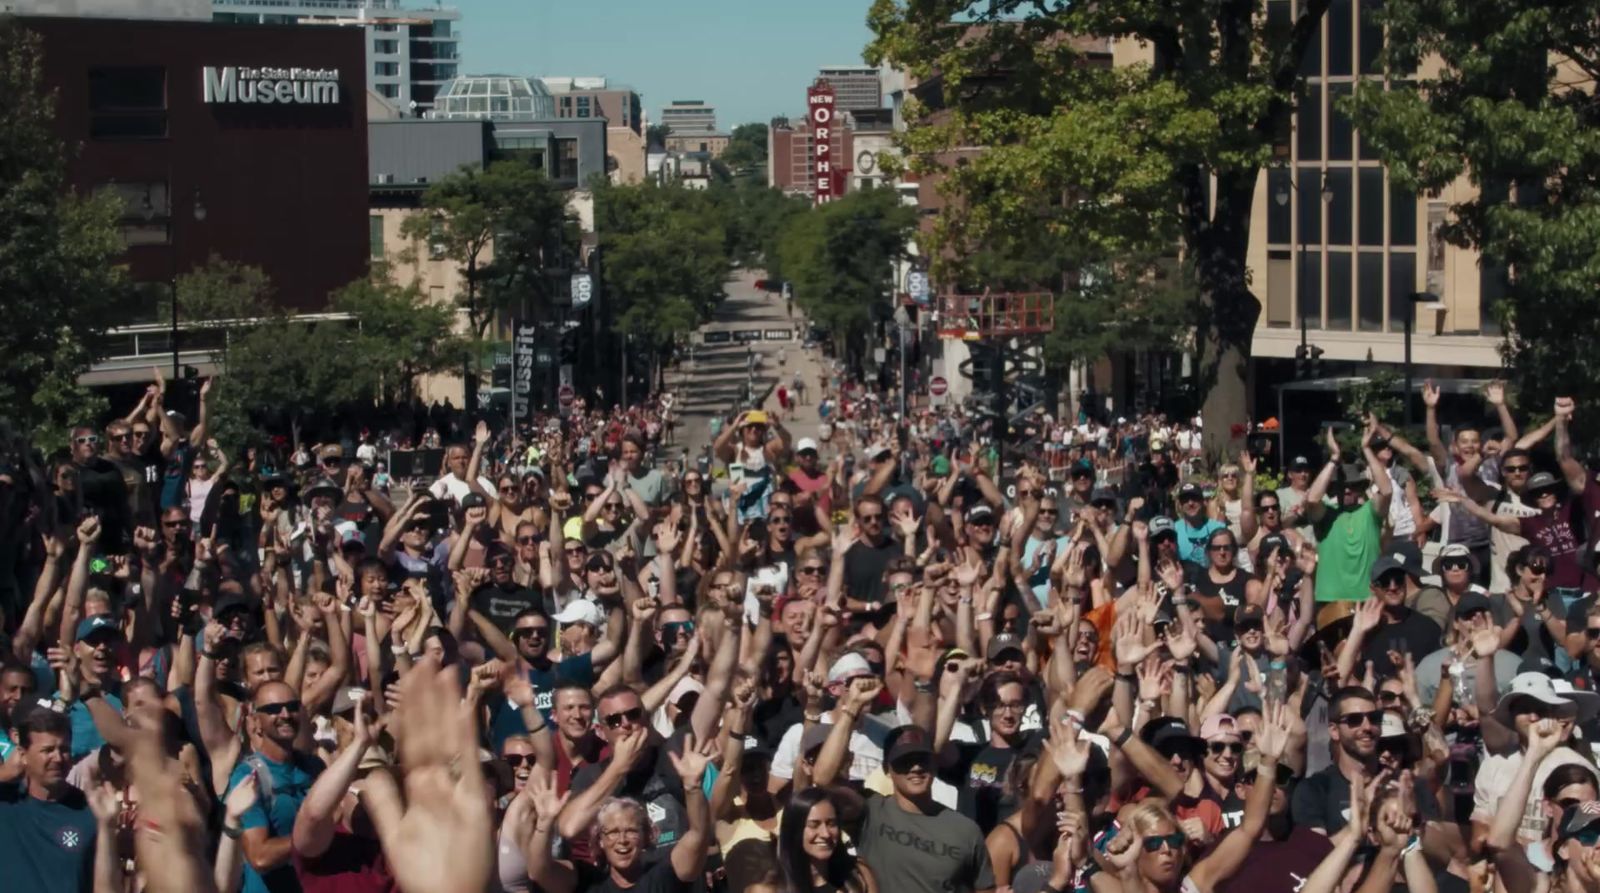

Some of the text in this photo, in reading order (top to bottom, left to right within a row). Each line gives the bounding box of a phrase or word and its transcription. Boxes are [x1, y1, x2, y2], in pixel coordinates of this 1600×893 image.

[203, 66, 339, 103] Museum
[238, 66, 260, 79] The
[260, 67, 289, 80] State
[810, 95, 833, 104] NEW
[879, 823, 962, 861] ROGUE
